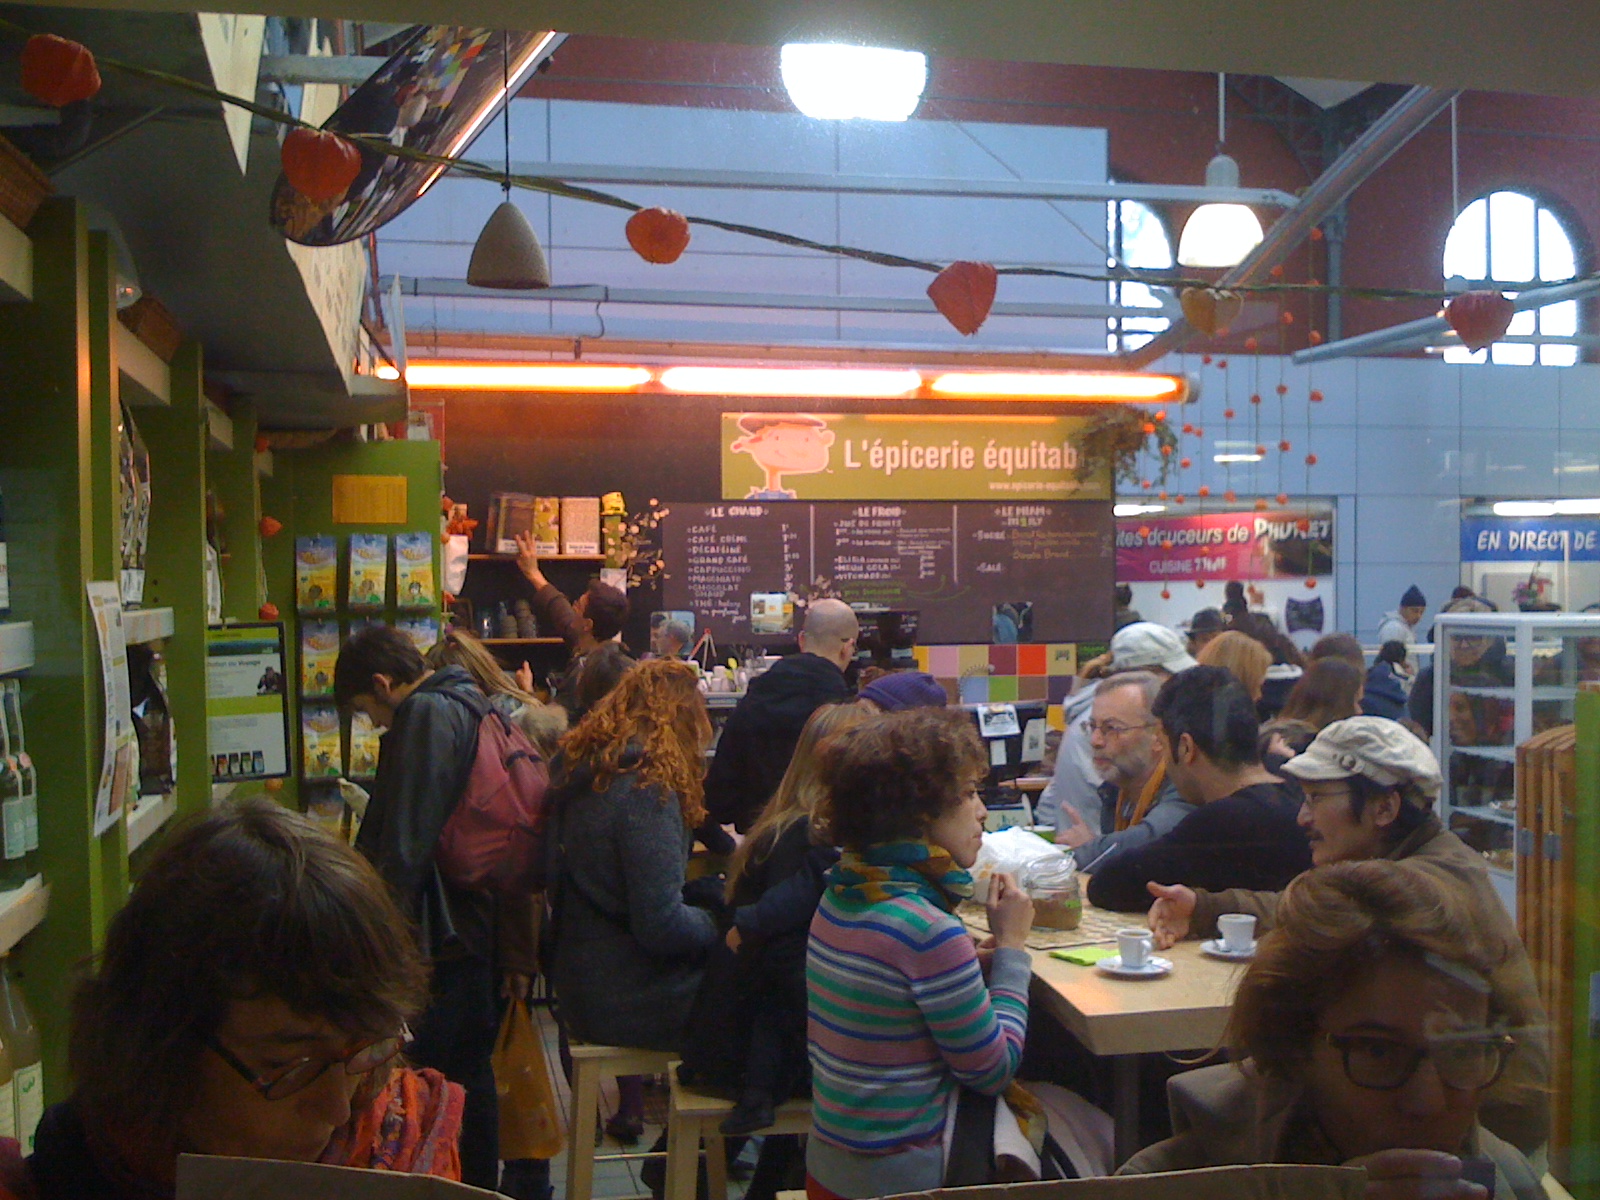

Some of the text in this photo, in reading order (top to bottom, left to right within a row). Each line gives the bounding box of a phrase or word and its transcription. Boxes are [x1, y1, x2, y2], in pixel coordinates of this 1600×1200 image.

[844, 438, 1085, 475] L'épicerie équitab
[711, 506, 725, 518] LE
[857, 506, 871, 518] LE
[1001, 505, 1014, 517] LE
[692, 524, 717, 534] CAFÉ
[1147, 527, 1223, 547] douceurs
[1227, 523, 1249, 544] de
[692, 535, 716, 544] CAFÉ
[1477, 529, 1501, 552] EN
[1573, 529, 1598, 552] DE
[1149, 559, 1193, 575] CUISINE
